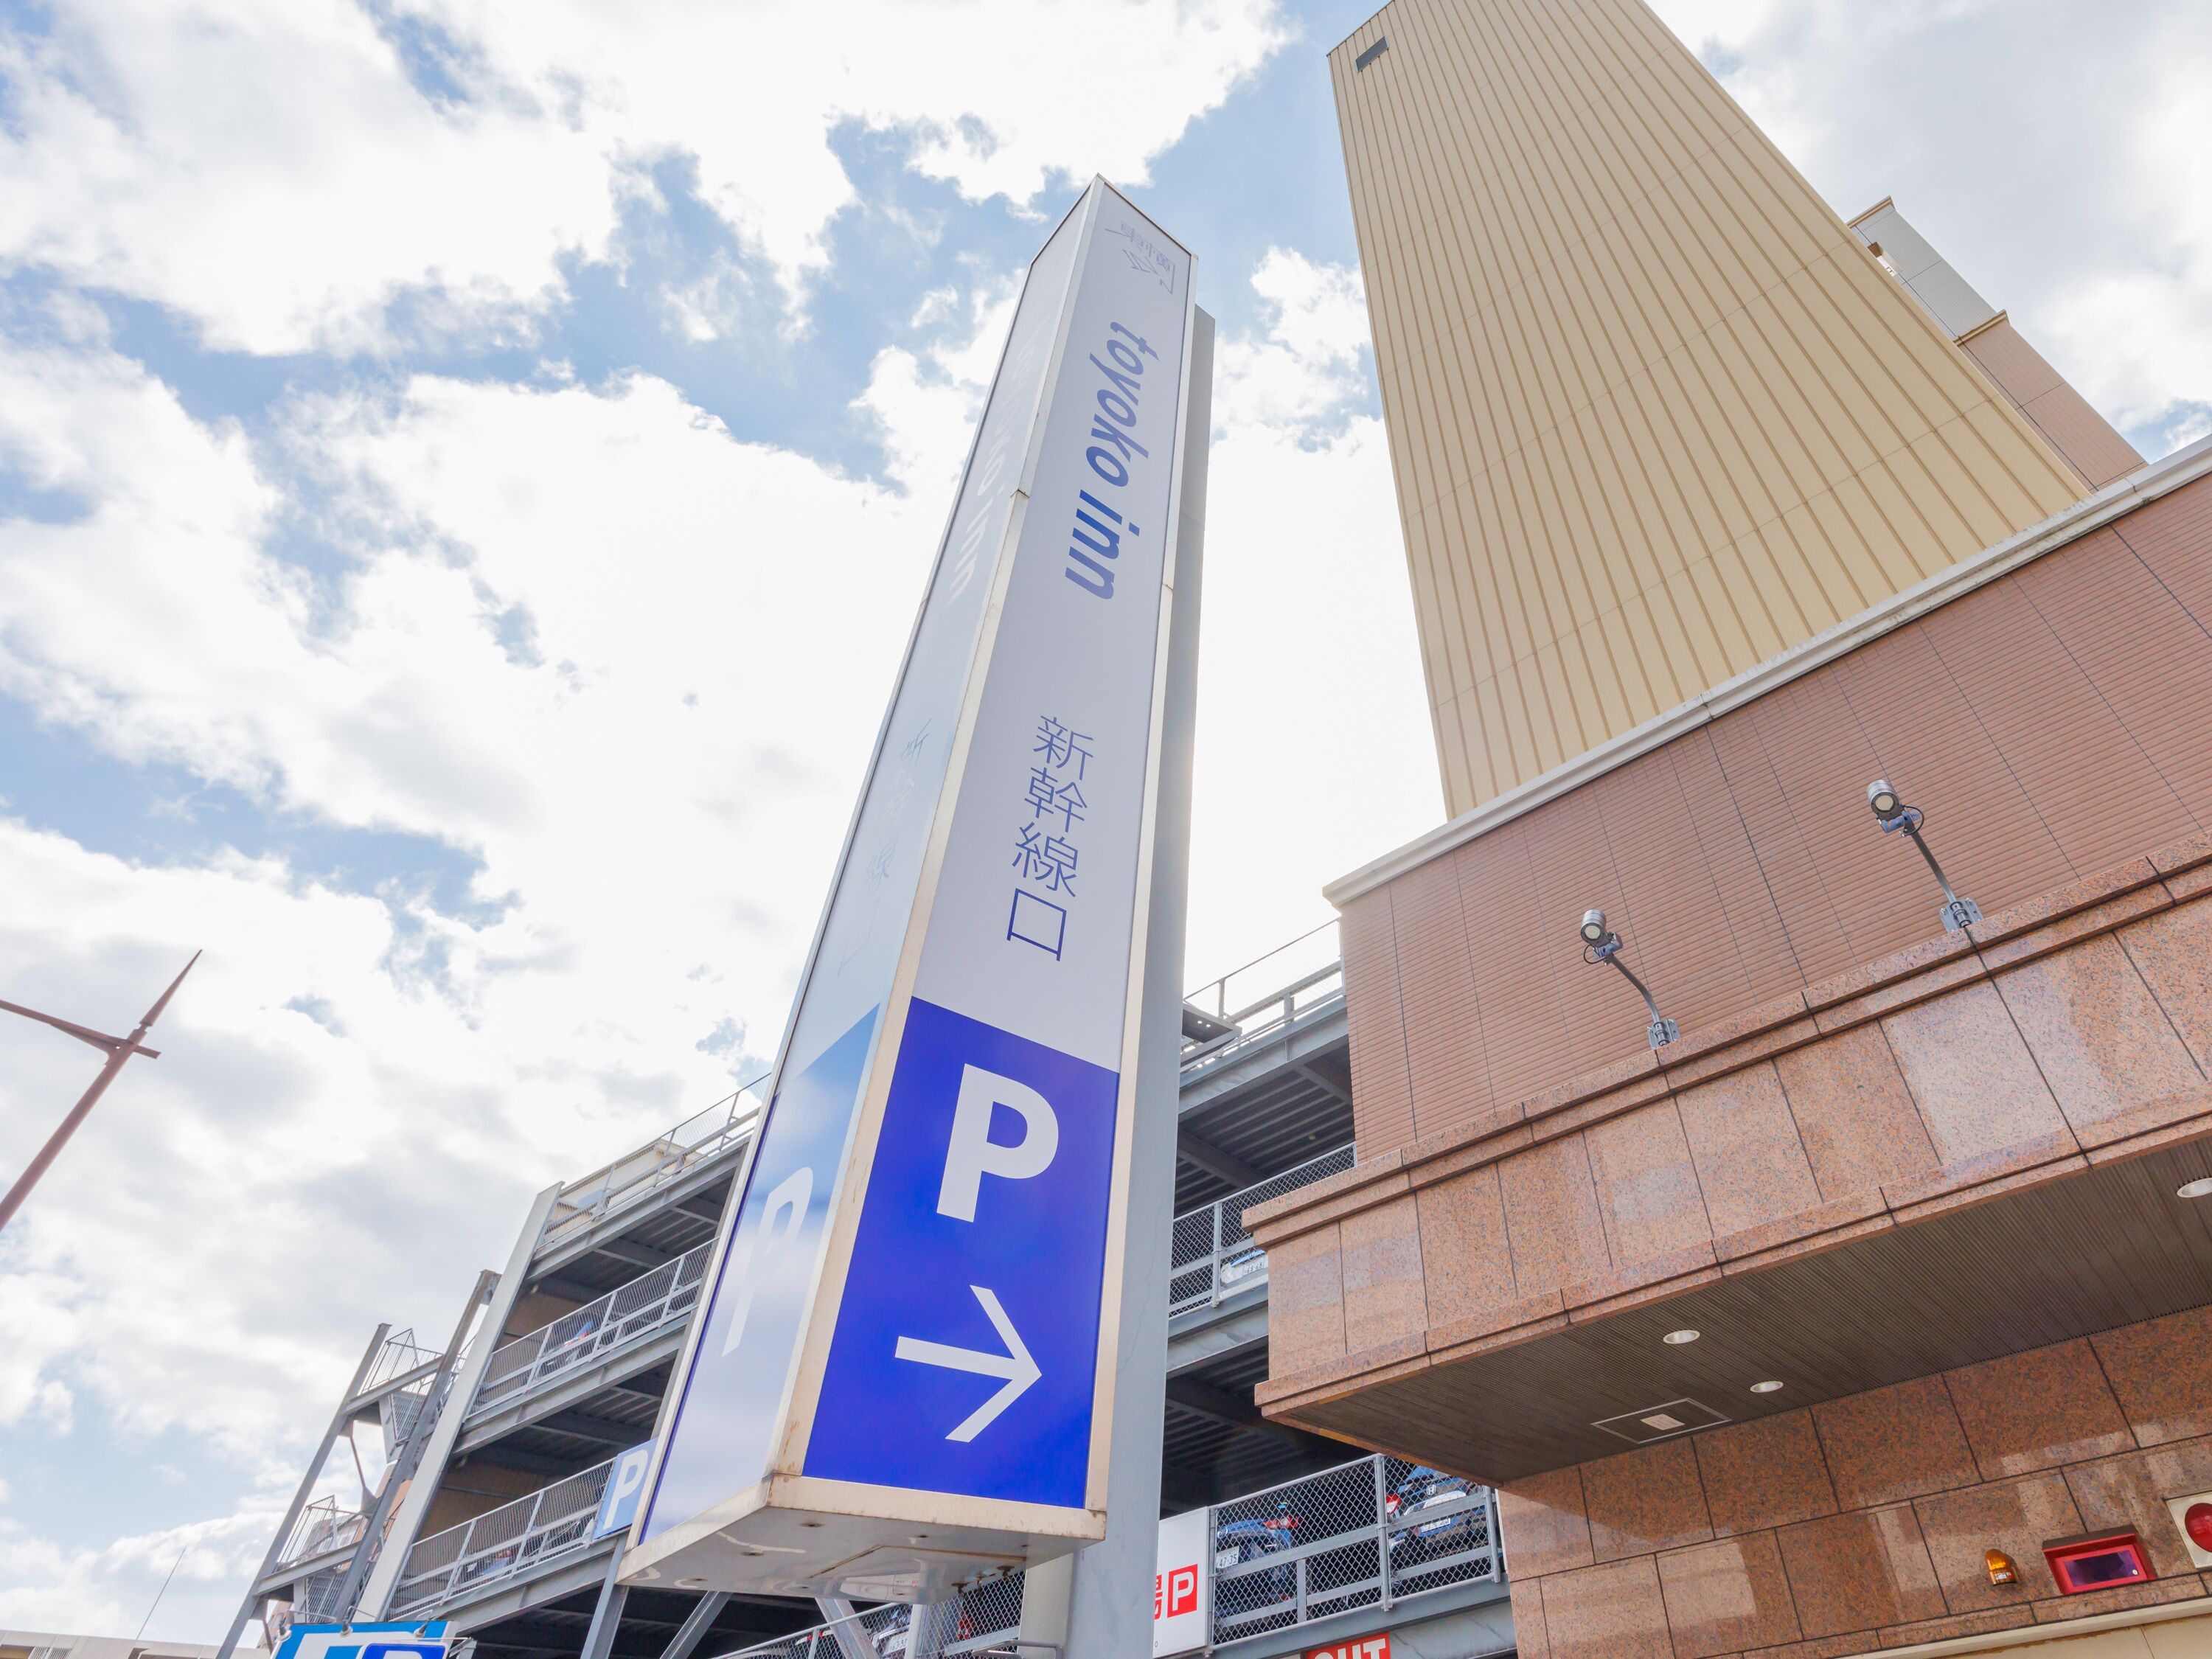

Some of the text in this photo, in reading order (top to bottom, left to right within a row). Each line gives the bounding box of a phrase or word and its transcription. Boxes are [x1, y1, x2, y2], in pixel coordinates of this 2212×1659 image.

[1065, 320, 1160, 600] toyoko inn
[1006, 714, 1094, 961] 新幹線口
[936, 1063, 1059, 1222] P
[722, 1166, 813, 1357] P
[603, 1450, 649, 1530] P
[1172, 1571, 1194, 1611] P
[1314, 1638, 1386, 1659] UT
